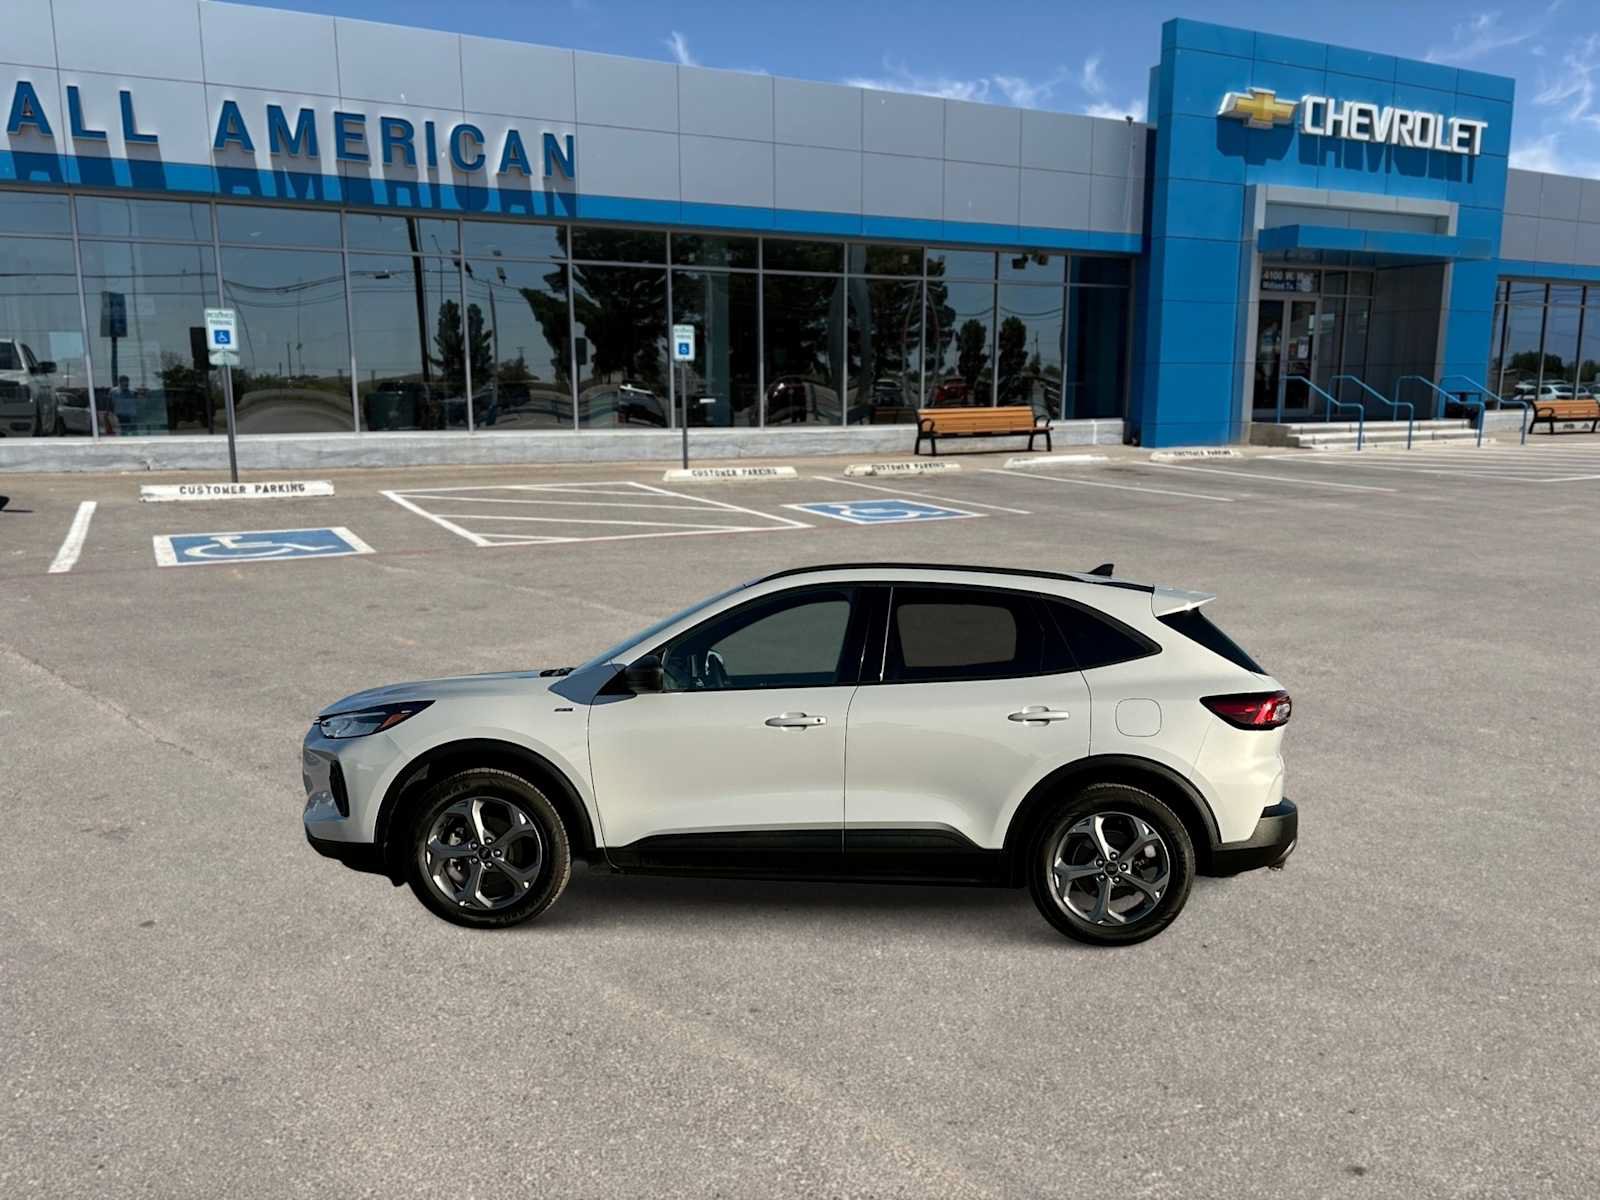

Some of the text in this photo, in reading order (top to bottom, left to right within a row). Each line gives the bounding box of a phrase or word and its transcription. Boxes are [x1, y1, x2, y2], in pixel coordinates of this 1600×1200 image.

[6, 80, 576, 179] ALL AMERICAN
[1301, 94, 1488, 155] CHEVROLET
[179, 483, 306, 495] CUSTOMER PARKING
[691, 468, 737, 477] CUSTOMER
